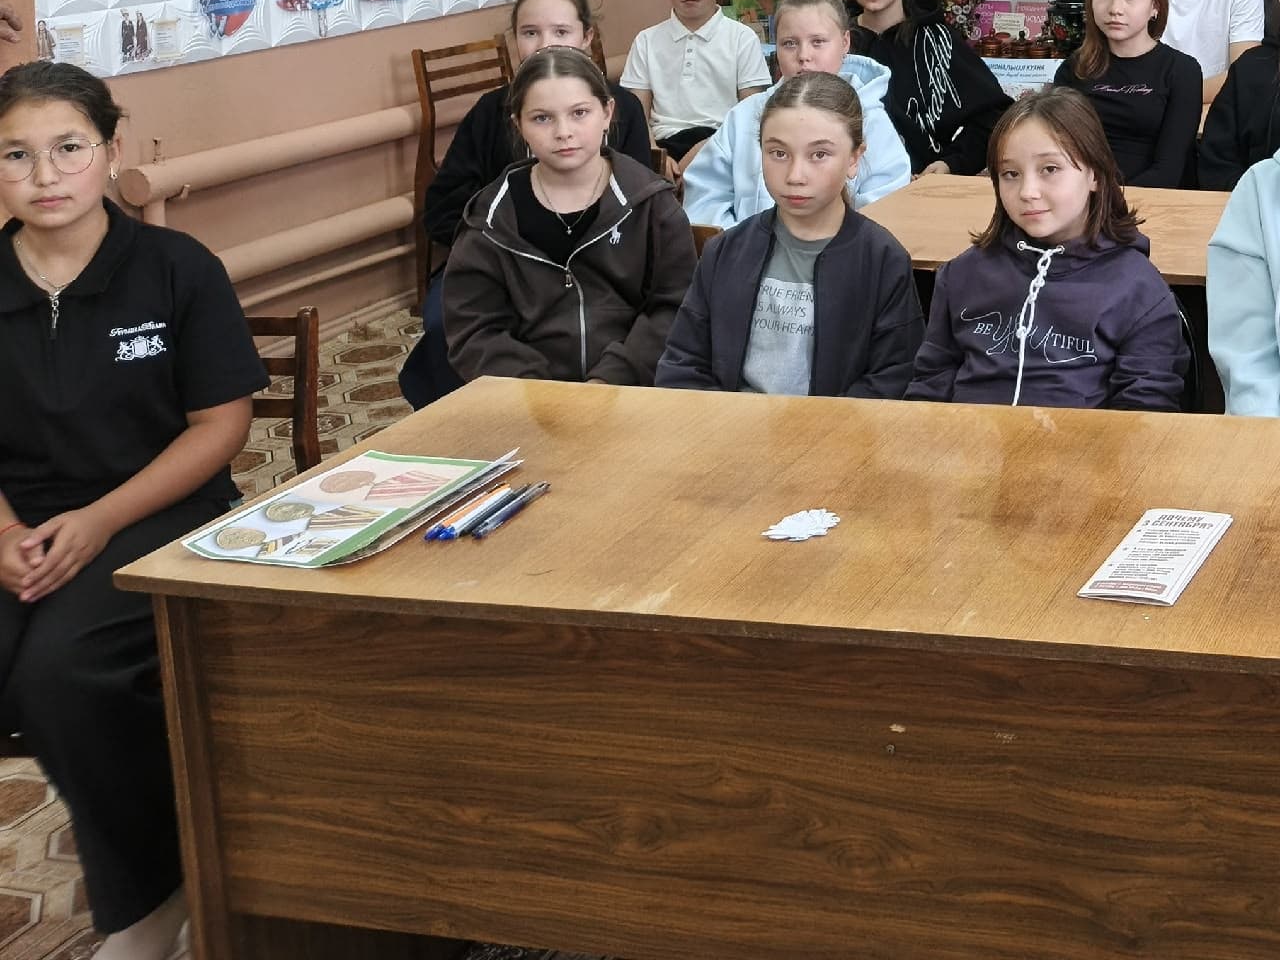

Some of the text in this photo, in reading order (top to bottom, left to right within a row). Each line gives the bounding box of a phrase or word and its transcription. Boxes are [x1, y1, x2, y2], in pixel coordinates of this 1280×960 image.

[786, 289, 814, 303] FRIEN
[766, 304, 807, 318] ALWAYS
[753, 318, 780, 332] YOUR
[1151, 520, 1214, 530] СЕНТЯБРЯ?
[1158, 514, 1205, 522] ПОЧЕМУ
